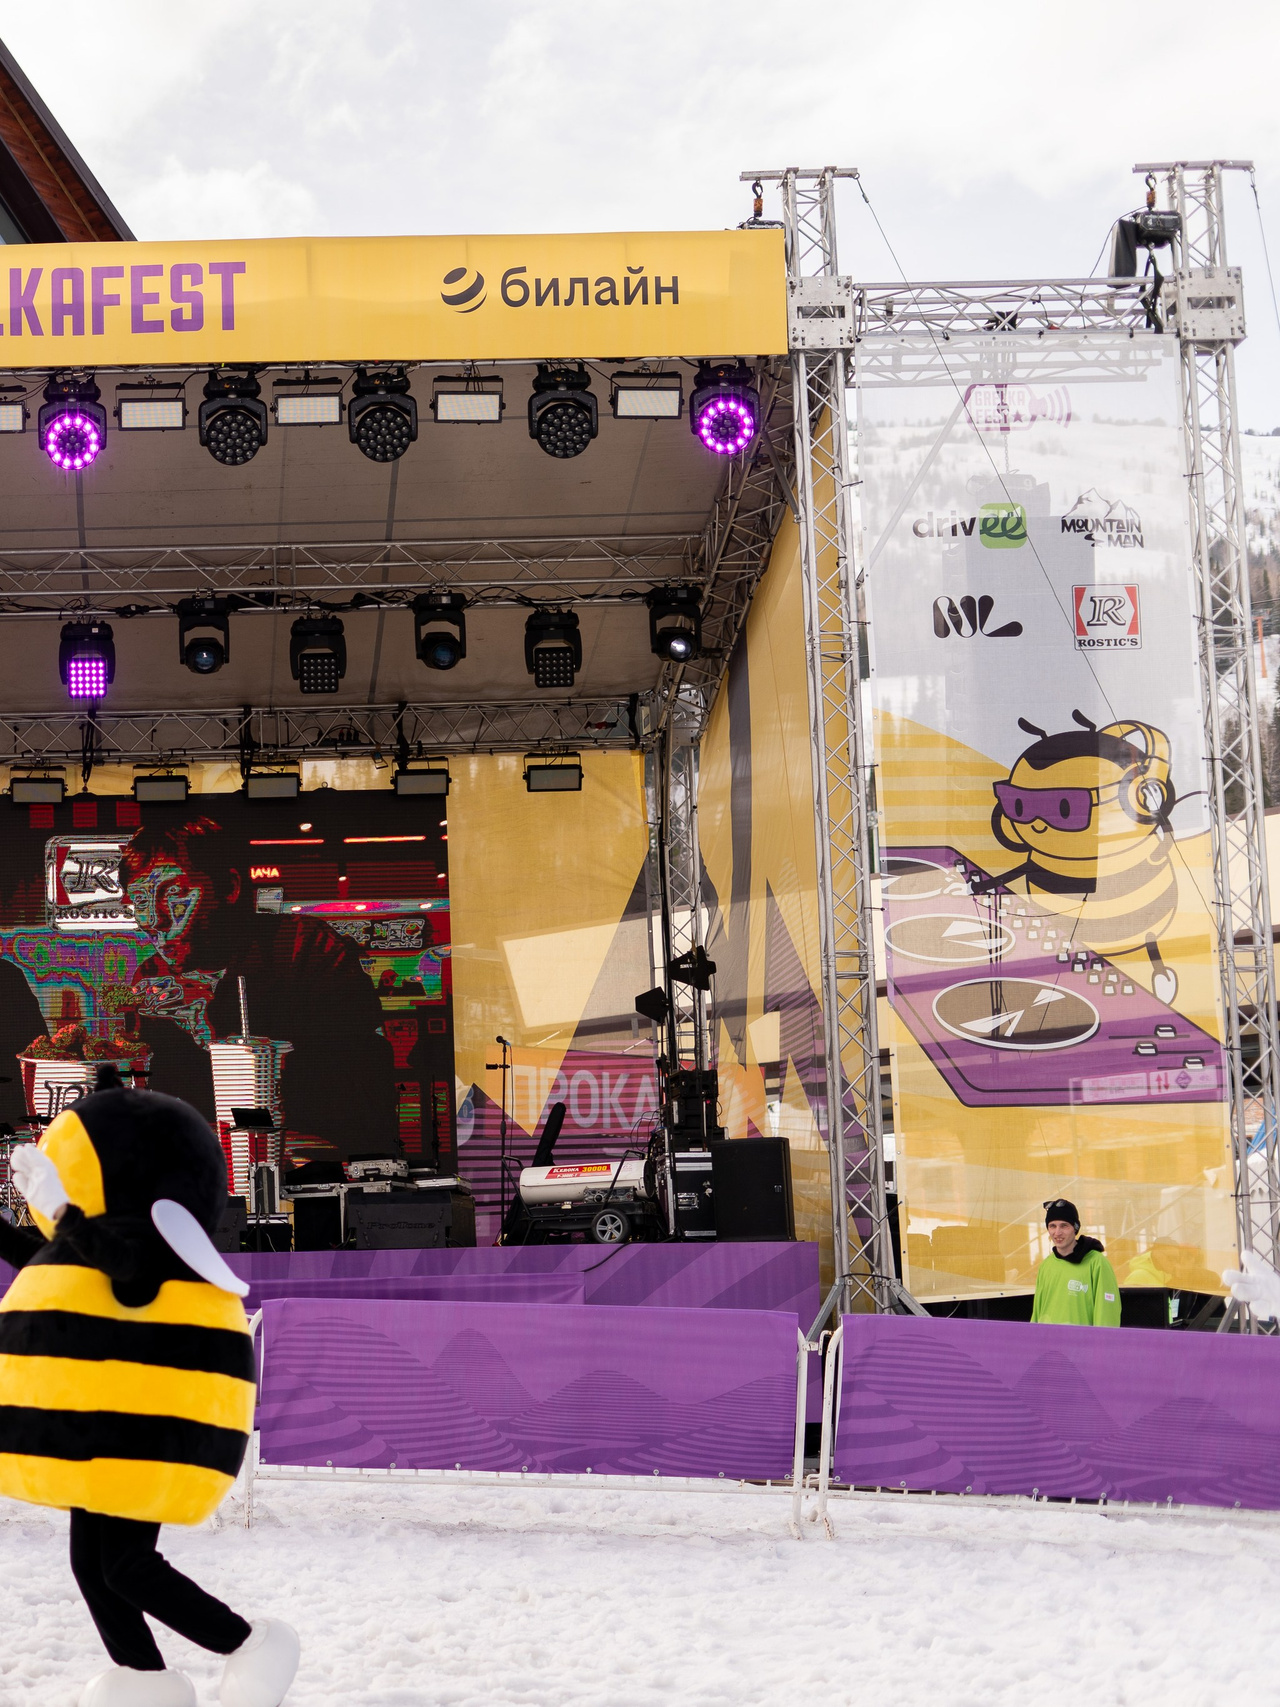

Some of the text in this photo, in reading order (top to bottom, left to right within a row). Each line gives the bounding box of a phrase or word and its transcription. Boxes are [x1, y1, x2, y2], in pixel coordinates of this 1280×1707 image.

[500, 266, 679, 308] билайн
[1061, 518, 1142, 533] MOUNTAIN
[1108, 534, 1145, 548] MAN
[933, 595, 1024, 638] NL
[1077, 637, 1139, 647] ROSTIC'S
